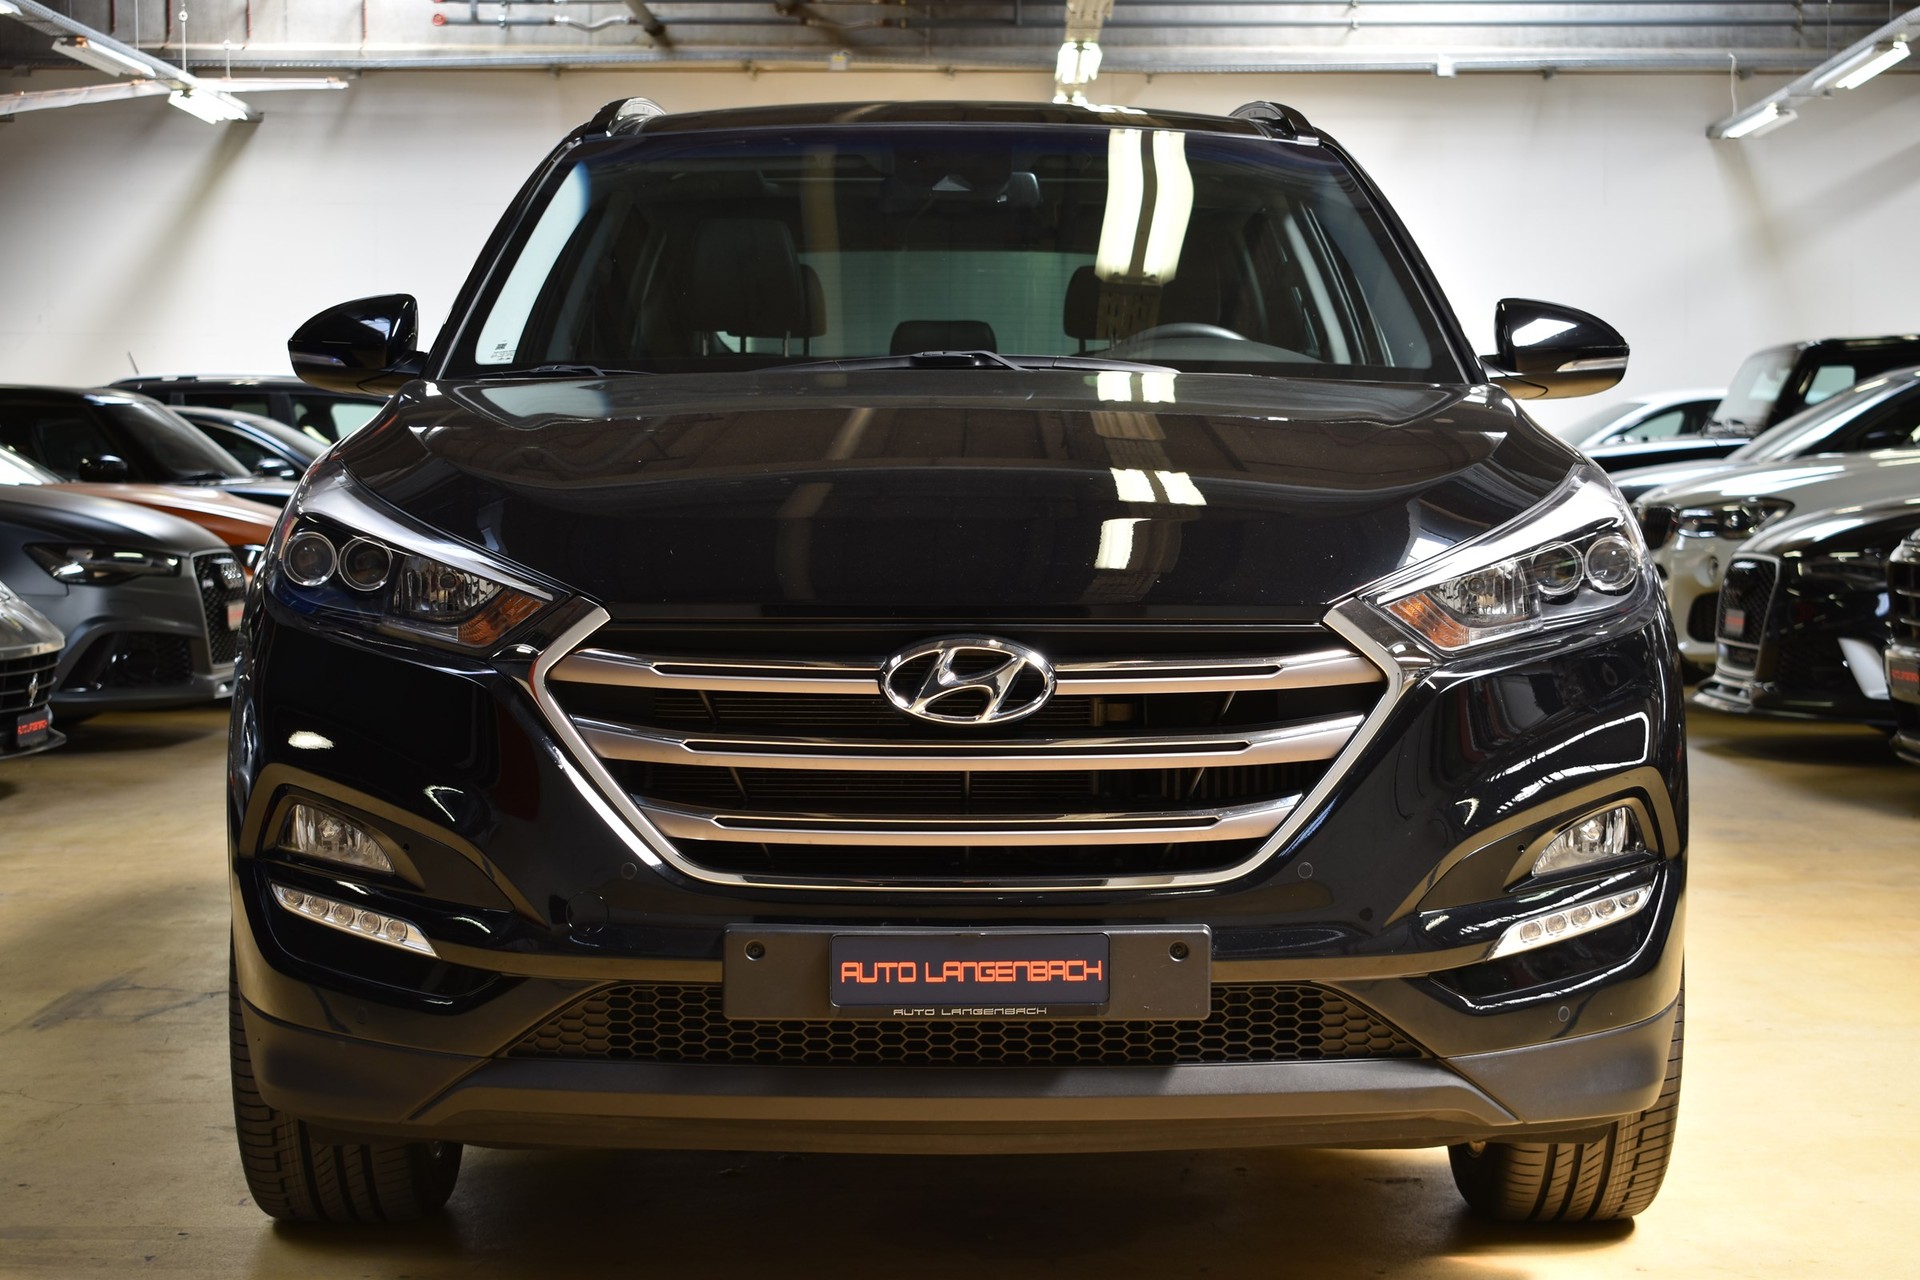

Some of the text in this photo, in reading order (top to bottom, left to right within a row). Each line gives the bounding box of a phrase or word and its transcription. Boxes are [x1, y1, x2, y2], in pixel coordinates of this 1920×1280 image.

[841, 960, 1102, 984] AUTO LANGENBACH
[893, 1007, 1048, 1016] AUTO LANGENBACH
